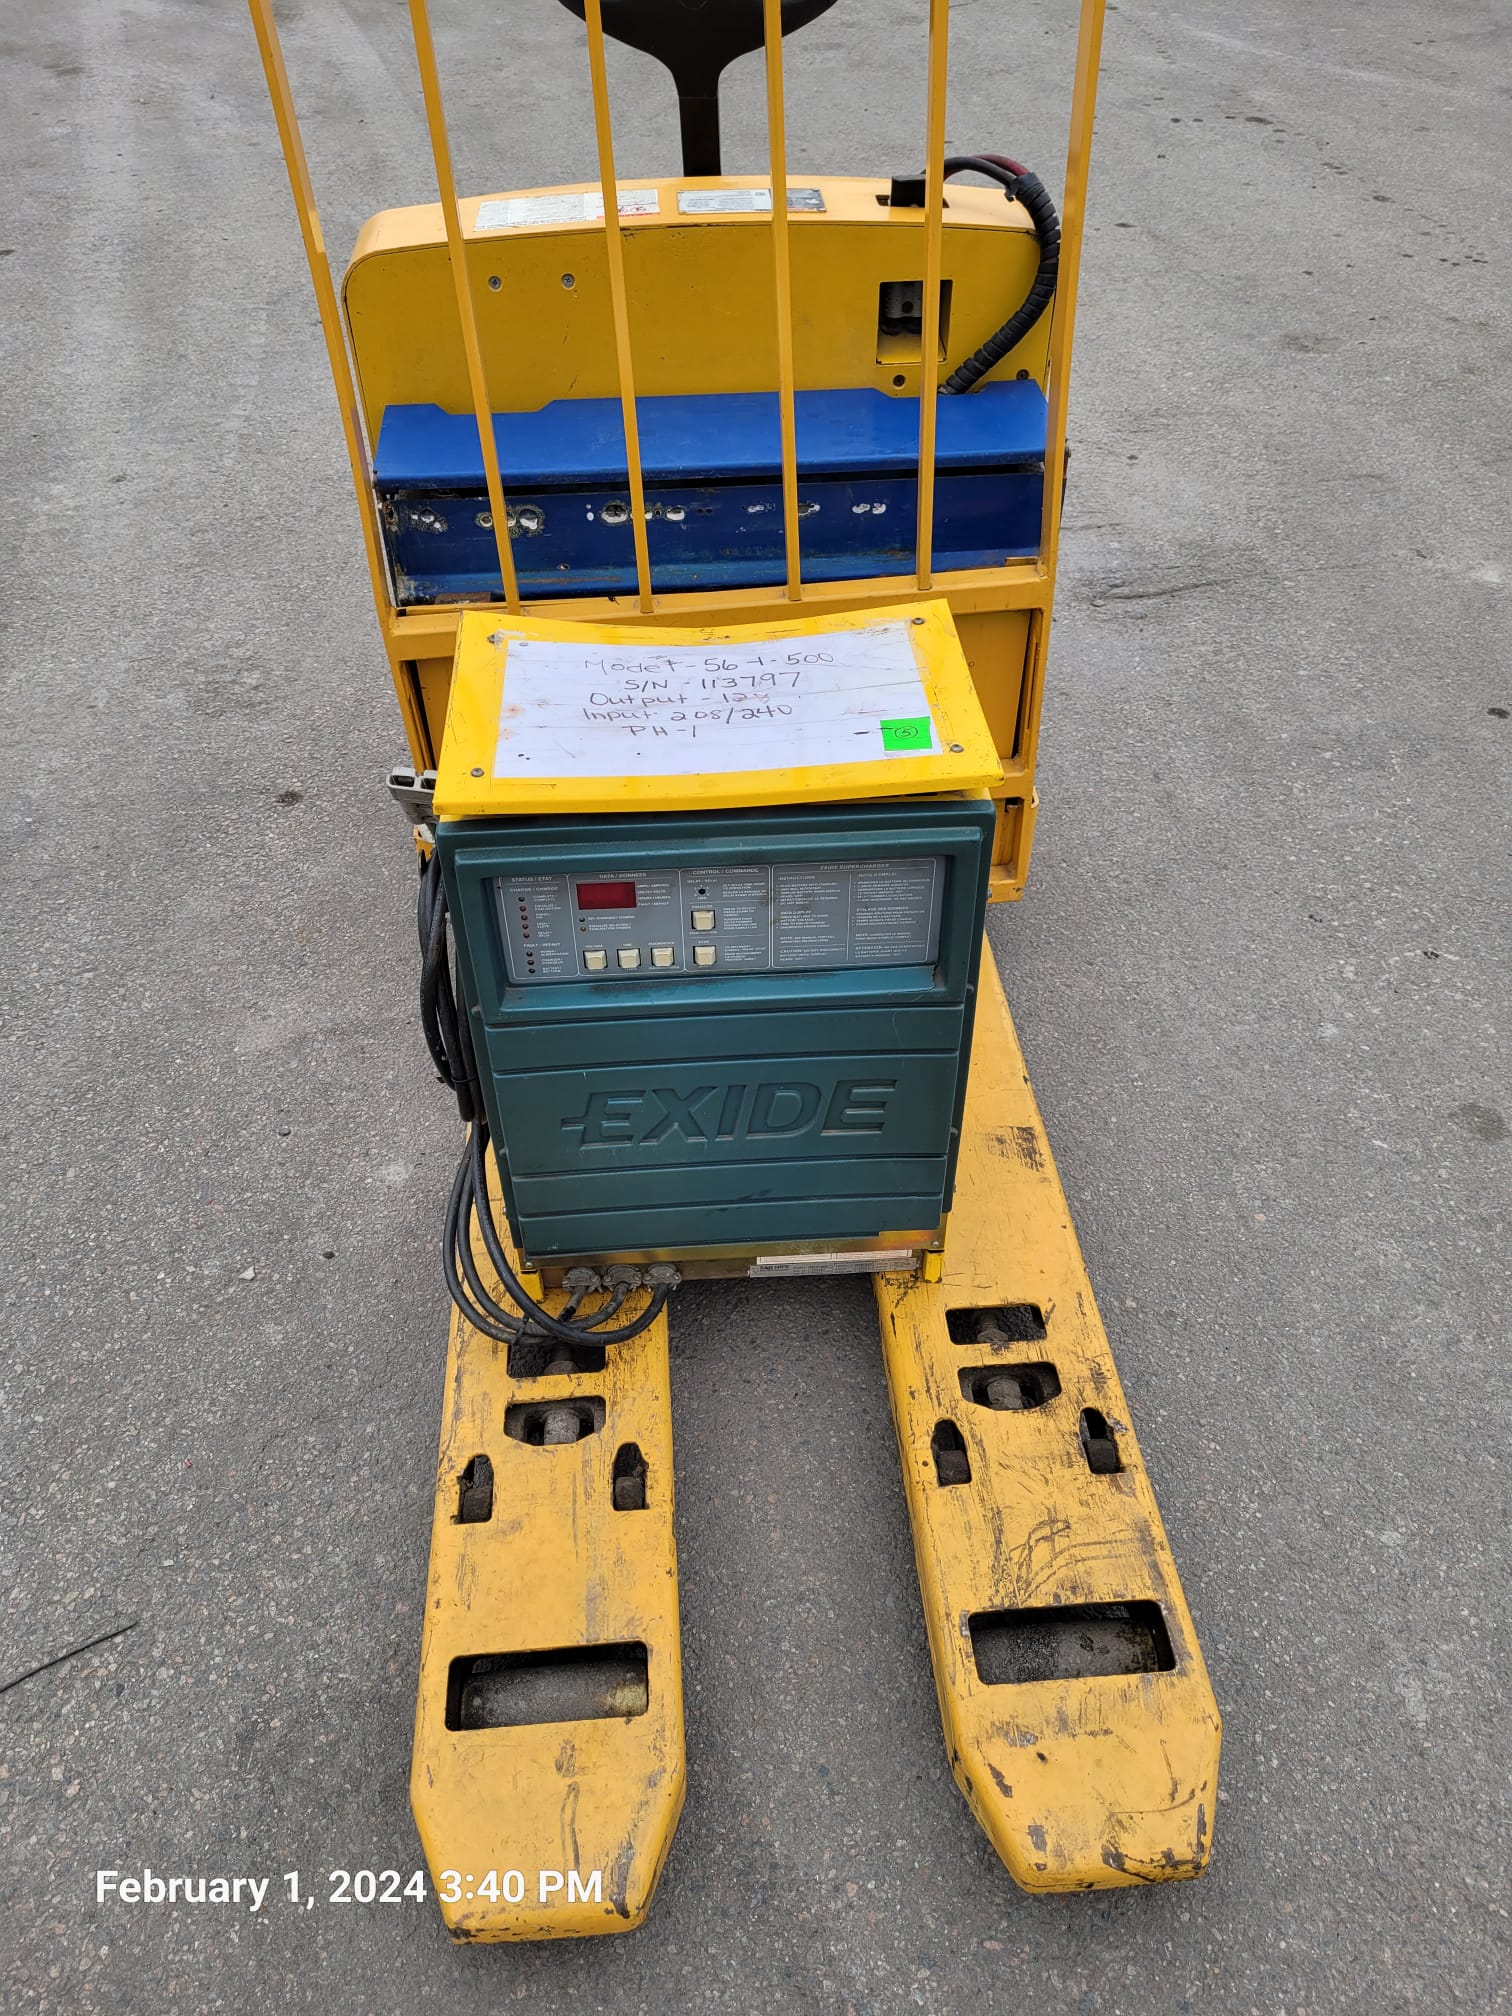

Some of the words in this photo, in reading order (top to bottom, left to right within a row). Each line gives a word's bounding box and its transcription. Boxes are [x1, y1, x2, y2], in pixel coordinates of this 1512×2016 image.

[701, 671, 801, 690] 113797
[590, 691, 689, 707] Output
[561, 1079, 899, 1150] EXIDE
